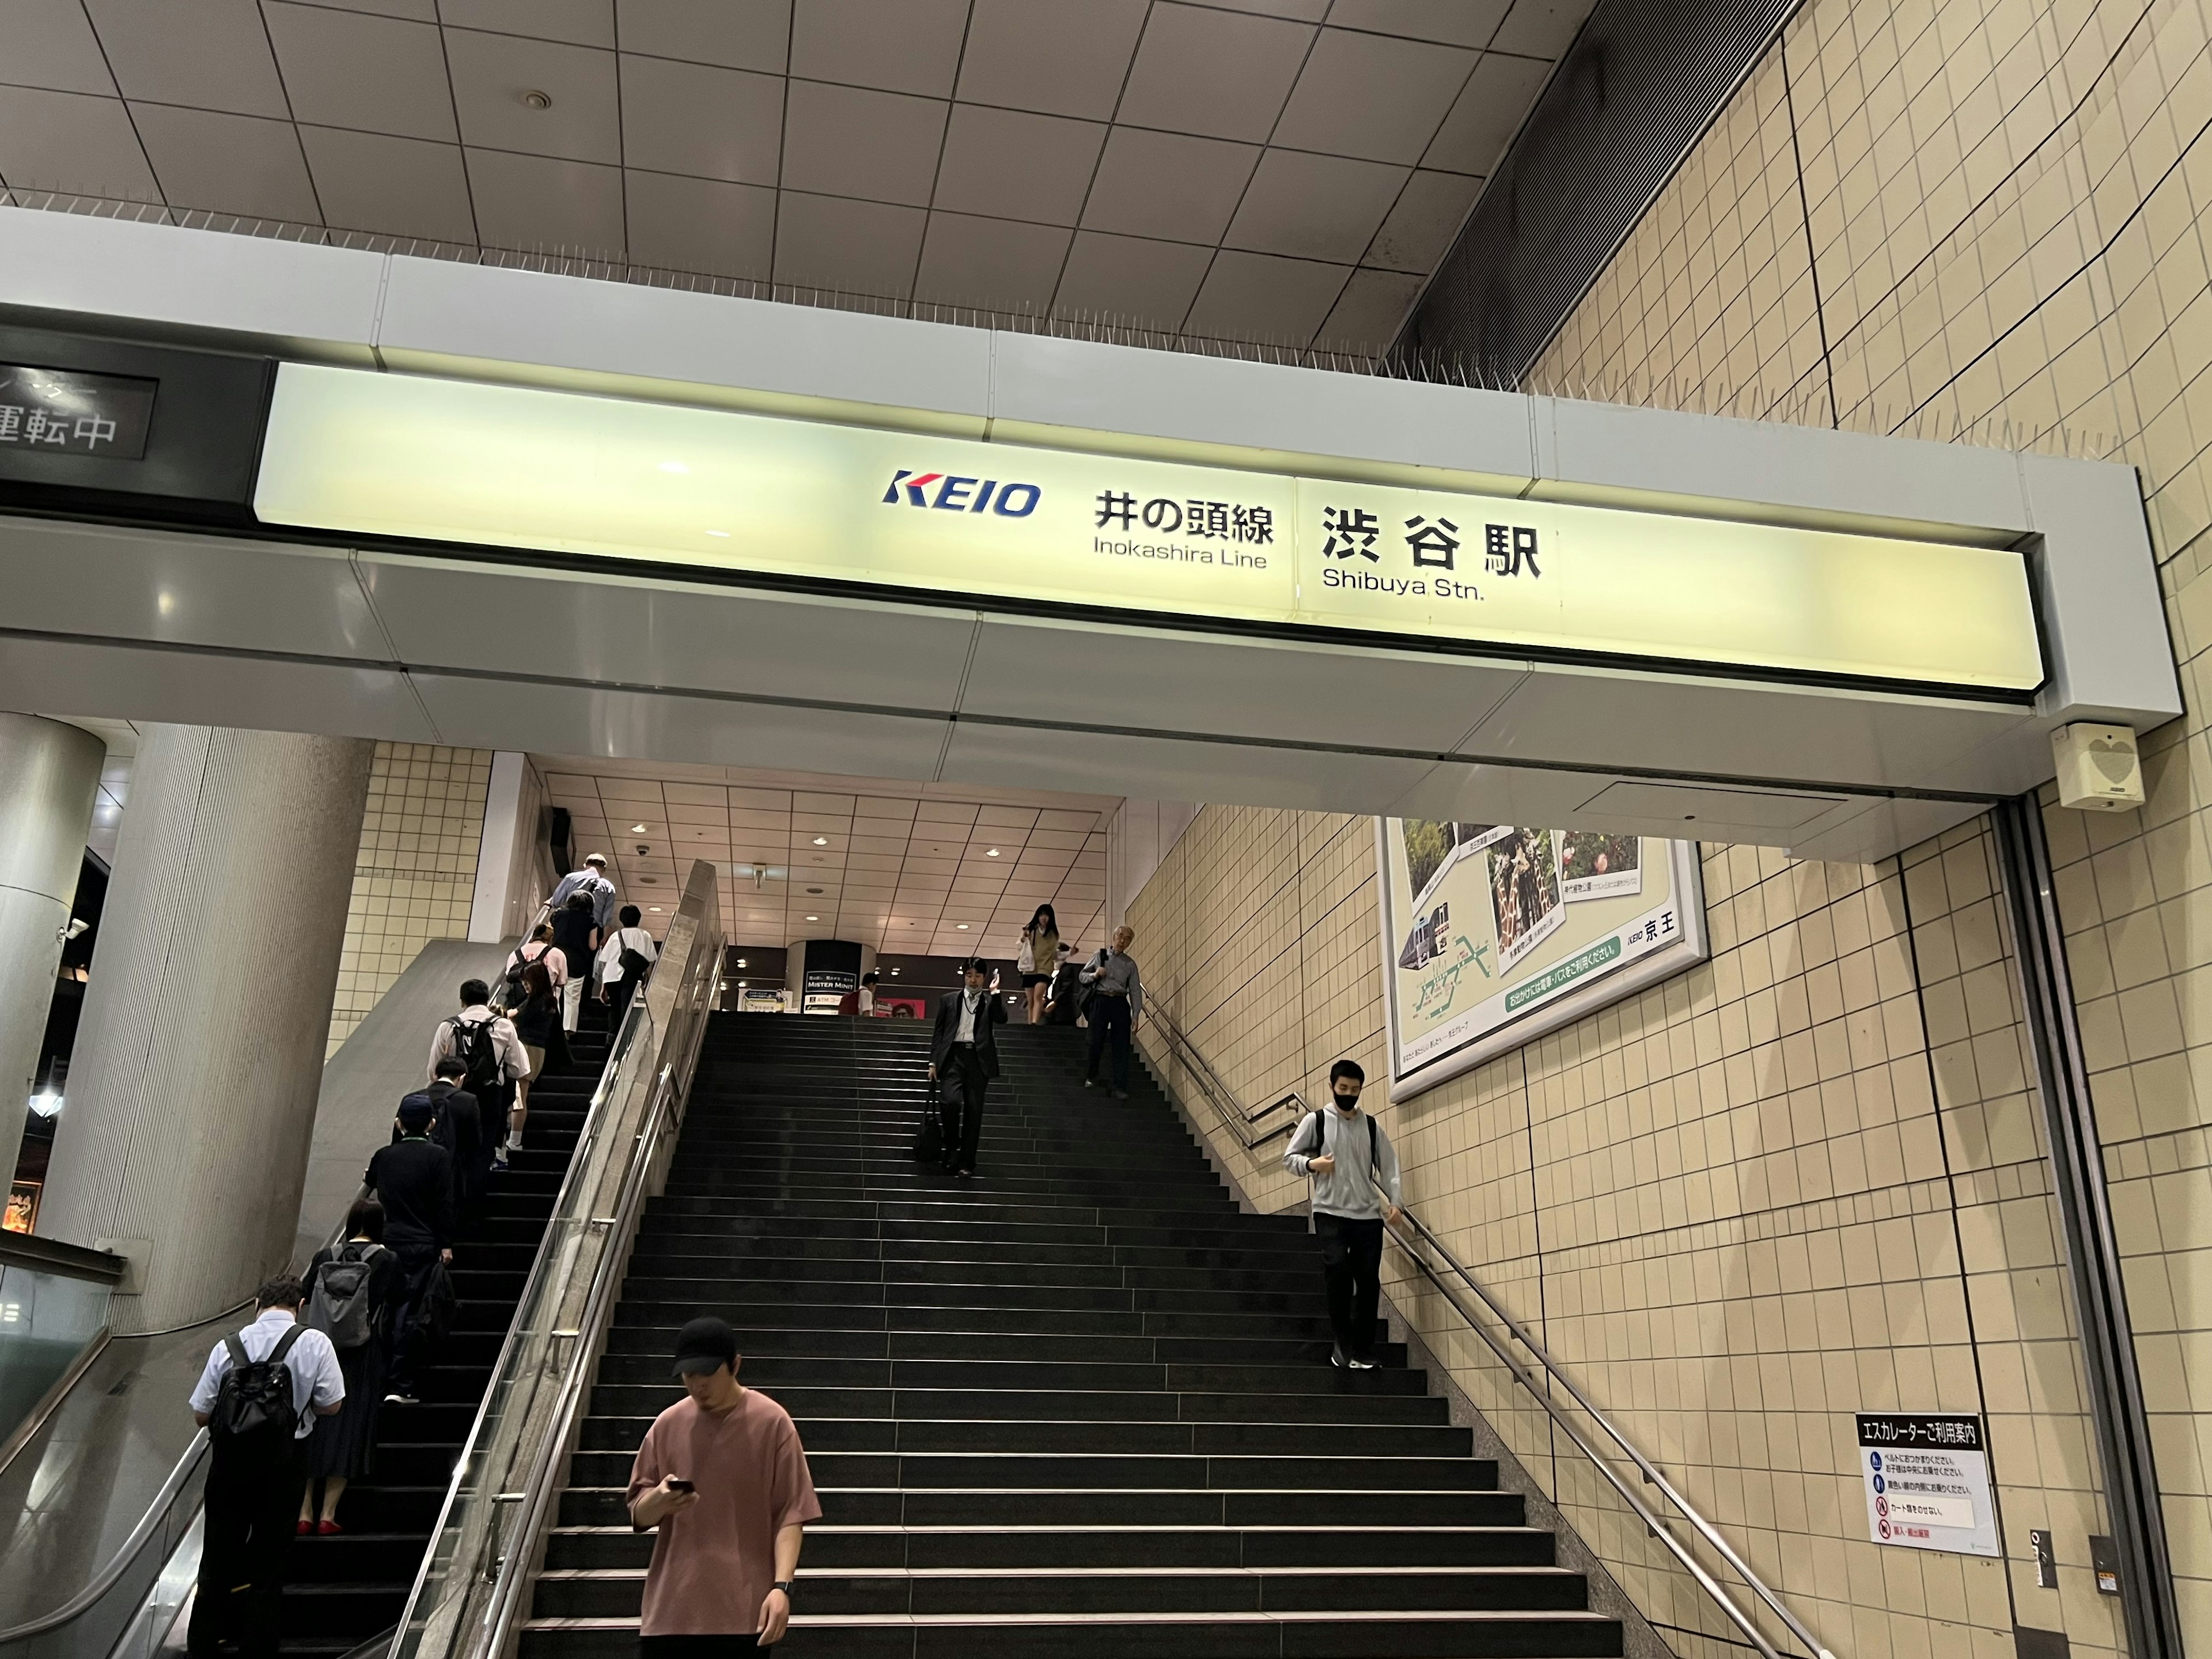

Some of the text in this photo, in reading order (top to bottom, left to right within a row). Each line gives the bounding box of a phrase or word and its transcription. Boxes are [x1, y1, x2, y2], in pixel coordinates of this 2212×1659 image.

[882, 470, 1040, 517] KEIO
[1095, 490, 1274, 544] 井の頭線
[1094, 537, 1267, 569] Inokashira Line
[1324, 569, 1484, 600] Shibuya Stn.
[1627, 930, 1643, 945] KEIO
[1863, 1421, 1976, 1445] エスカレーターご利用案内
